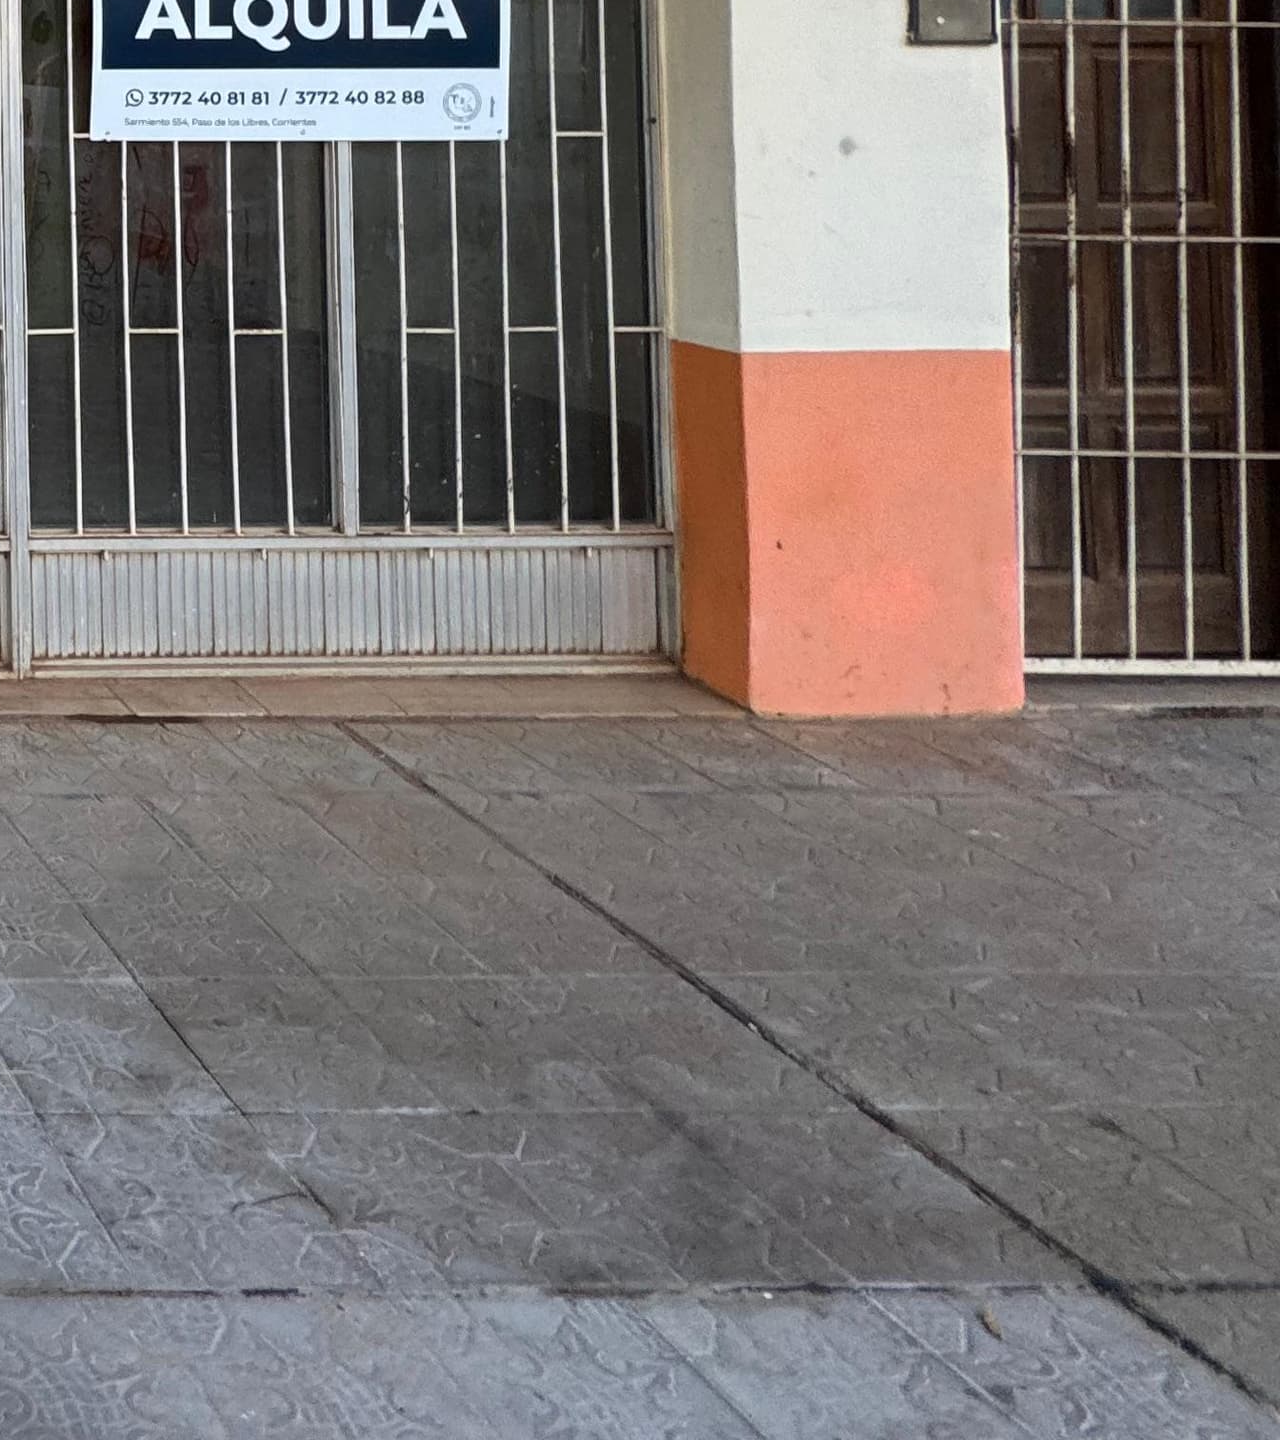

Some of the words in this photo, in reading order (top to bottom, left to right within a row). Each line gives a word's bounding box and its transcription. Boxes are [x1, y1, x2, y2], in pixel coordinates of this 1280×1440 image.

[148, 91, 192, 105] 3772
[197, 91, 221, 105] 40
[227, 91, 245, 105] 81
[251, 91, 269, 105] 81
[279, 87, 288, 106] /
[295, 90, 339, 104] 3772
[344, 90, 368, 105] 40
[374, 90, 396, 105] 82
[401, 90, 424, 104] 88
[124, 117, 170, 126] Sarmiento
[192, 118, 213, 126] Paso
[214, 118, 225, 126] de
[228, 117, 240, 126] los
